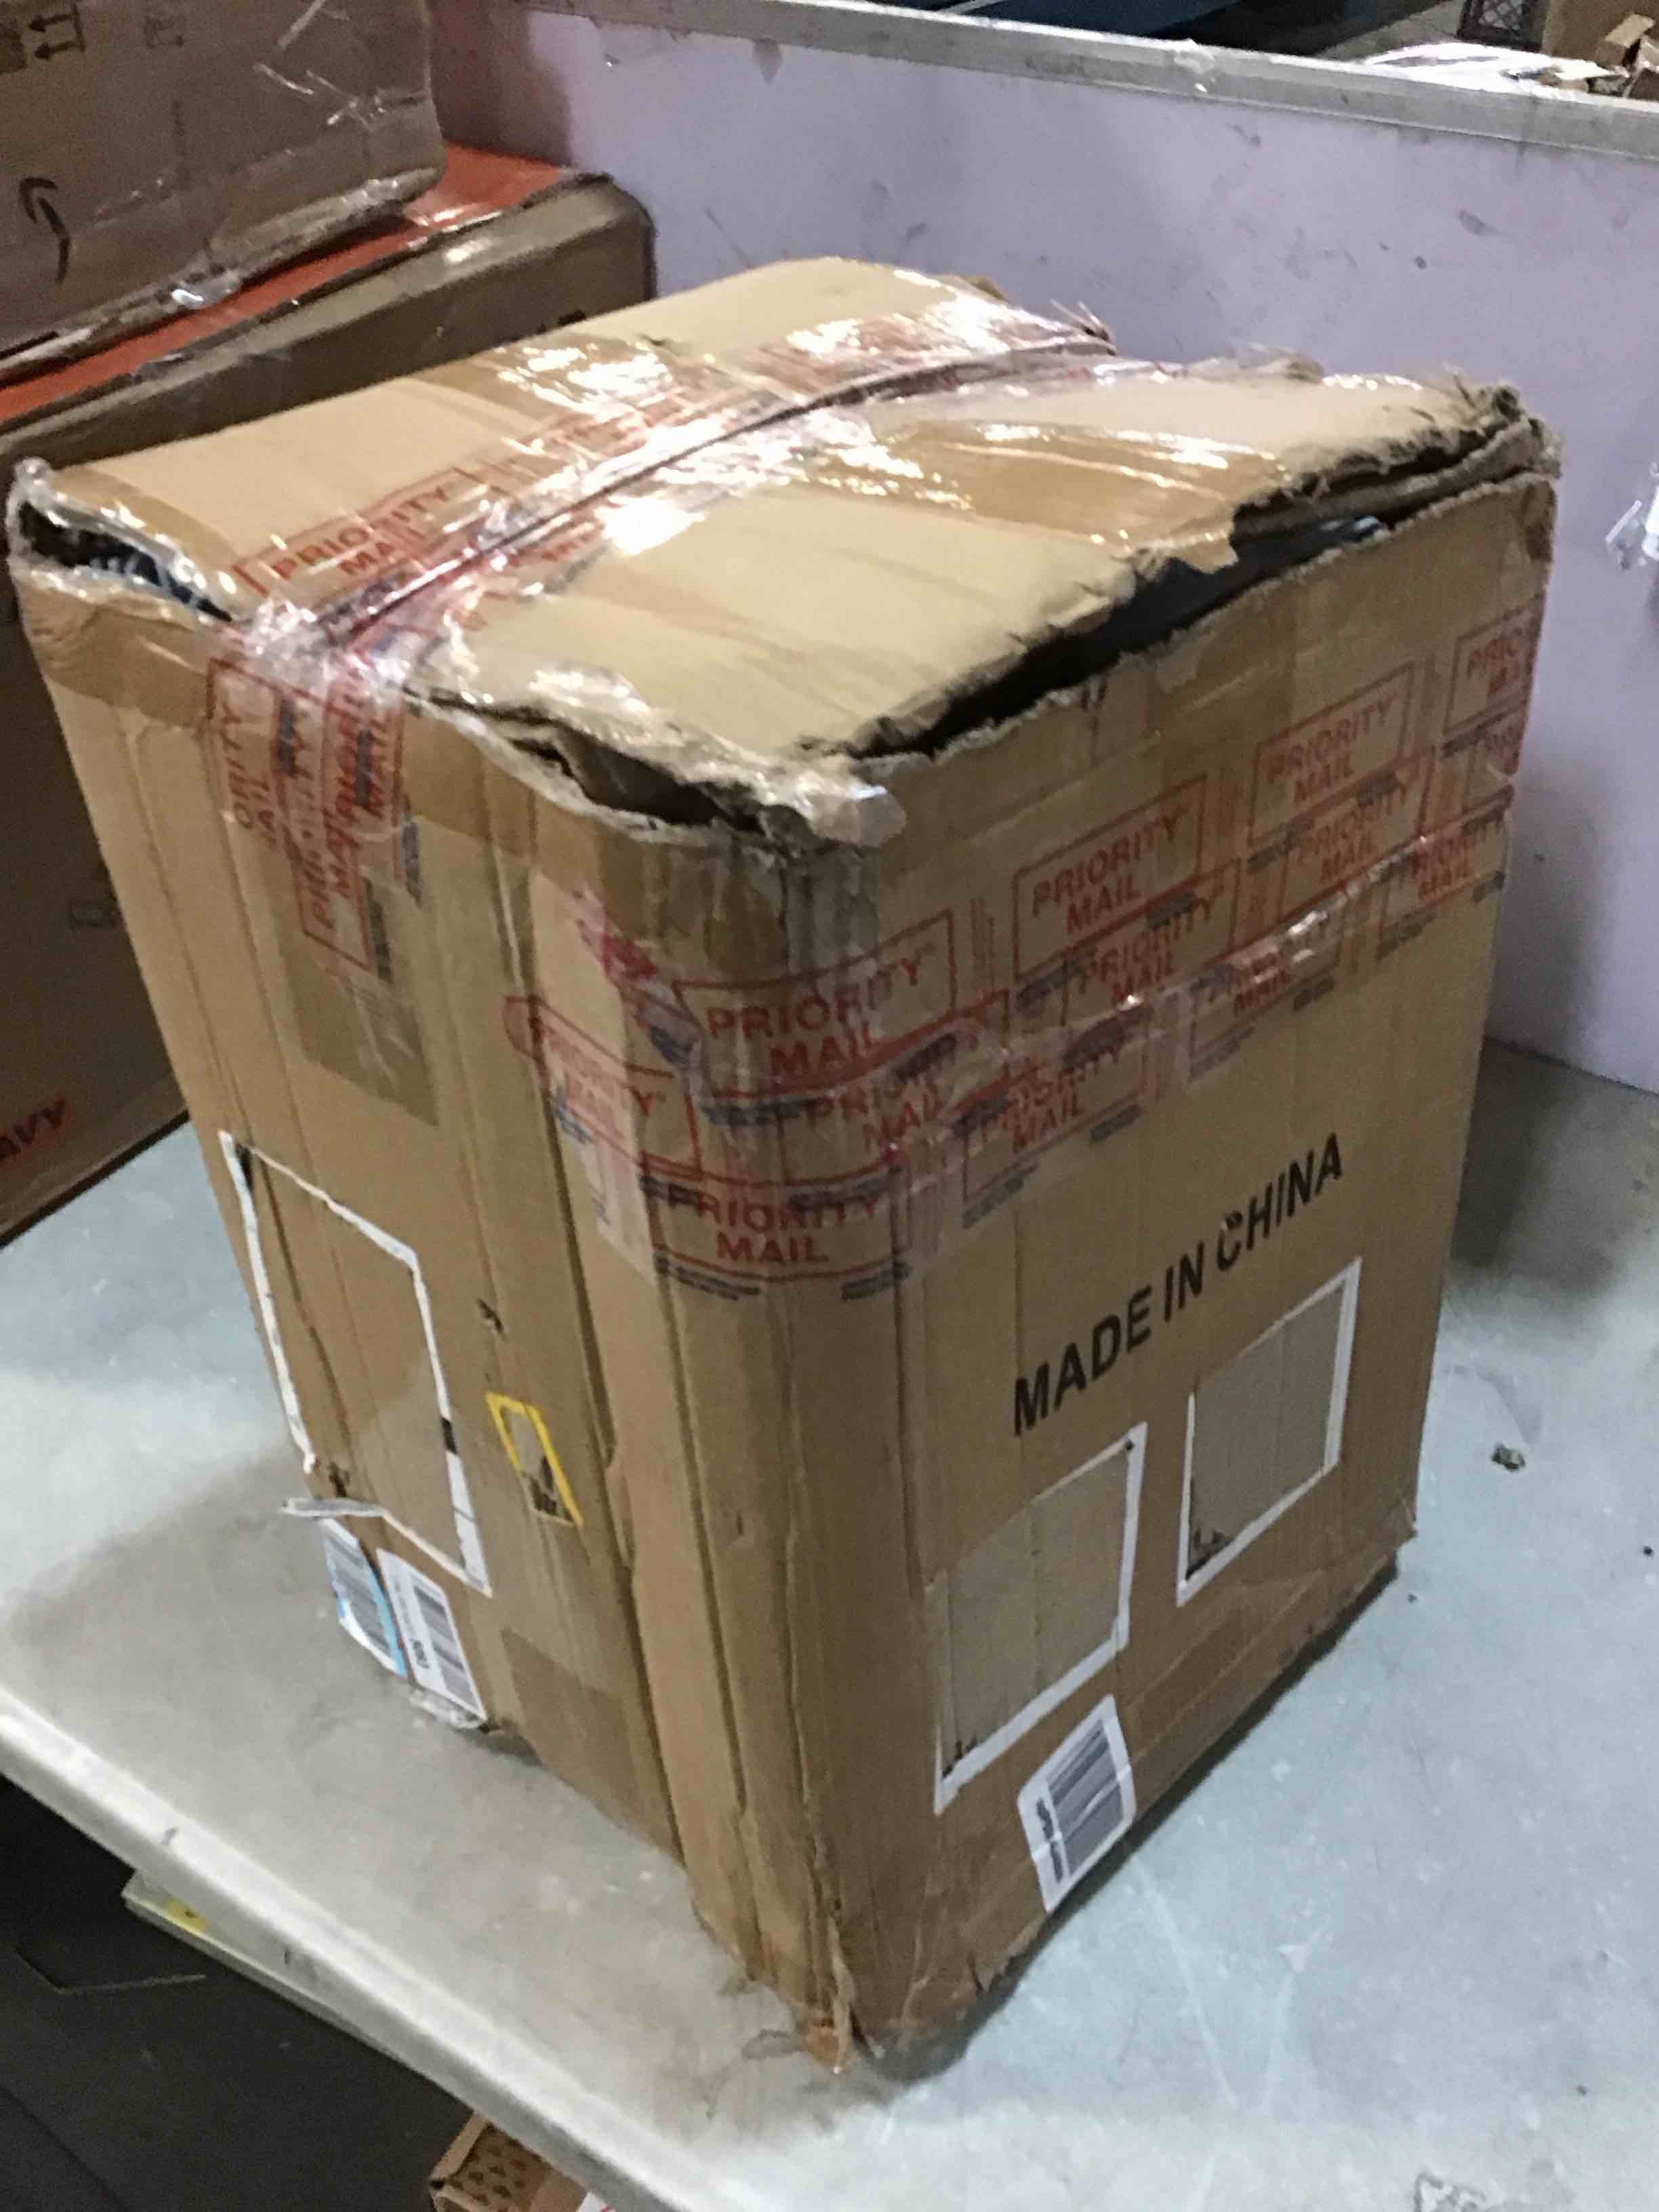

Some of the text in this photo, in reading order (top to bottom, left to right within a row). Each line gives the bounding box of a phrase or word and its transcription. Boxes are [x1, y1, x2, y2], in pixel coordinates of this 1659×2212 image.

[1031, 808, 1189, 919] PRIORITY
[1066, 876, 1141, 935] MAIL
[770, 1019, 880, 1080] MAIL
[715, 1232, 829, 1263] MAIL
[1014, 1132, 1343, 1437] MADE IN CHINA
